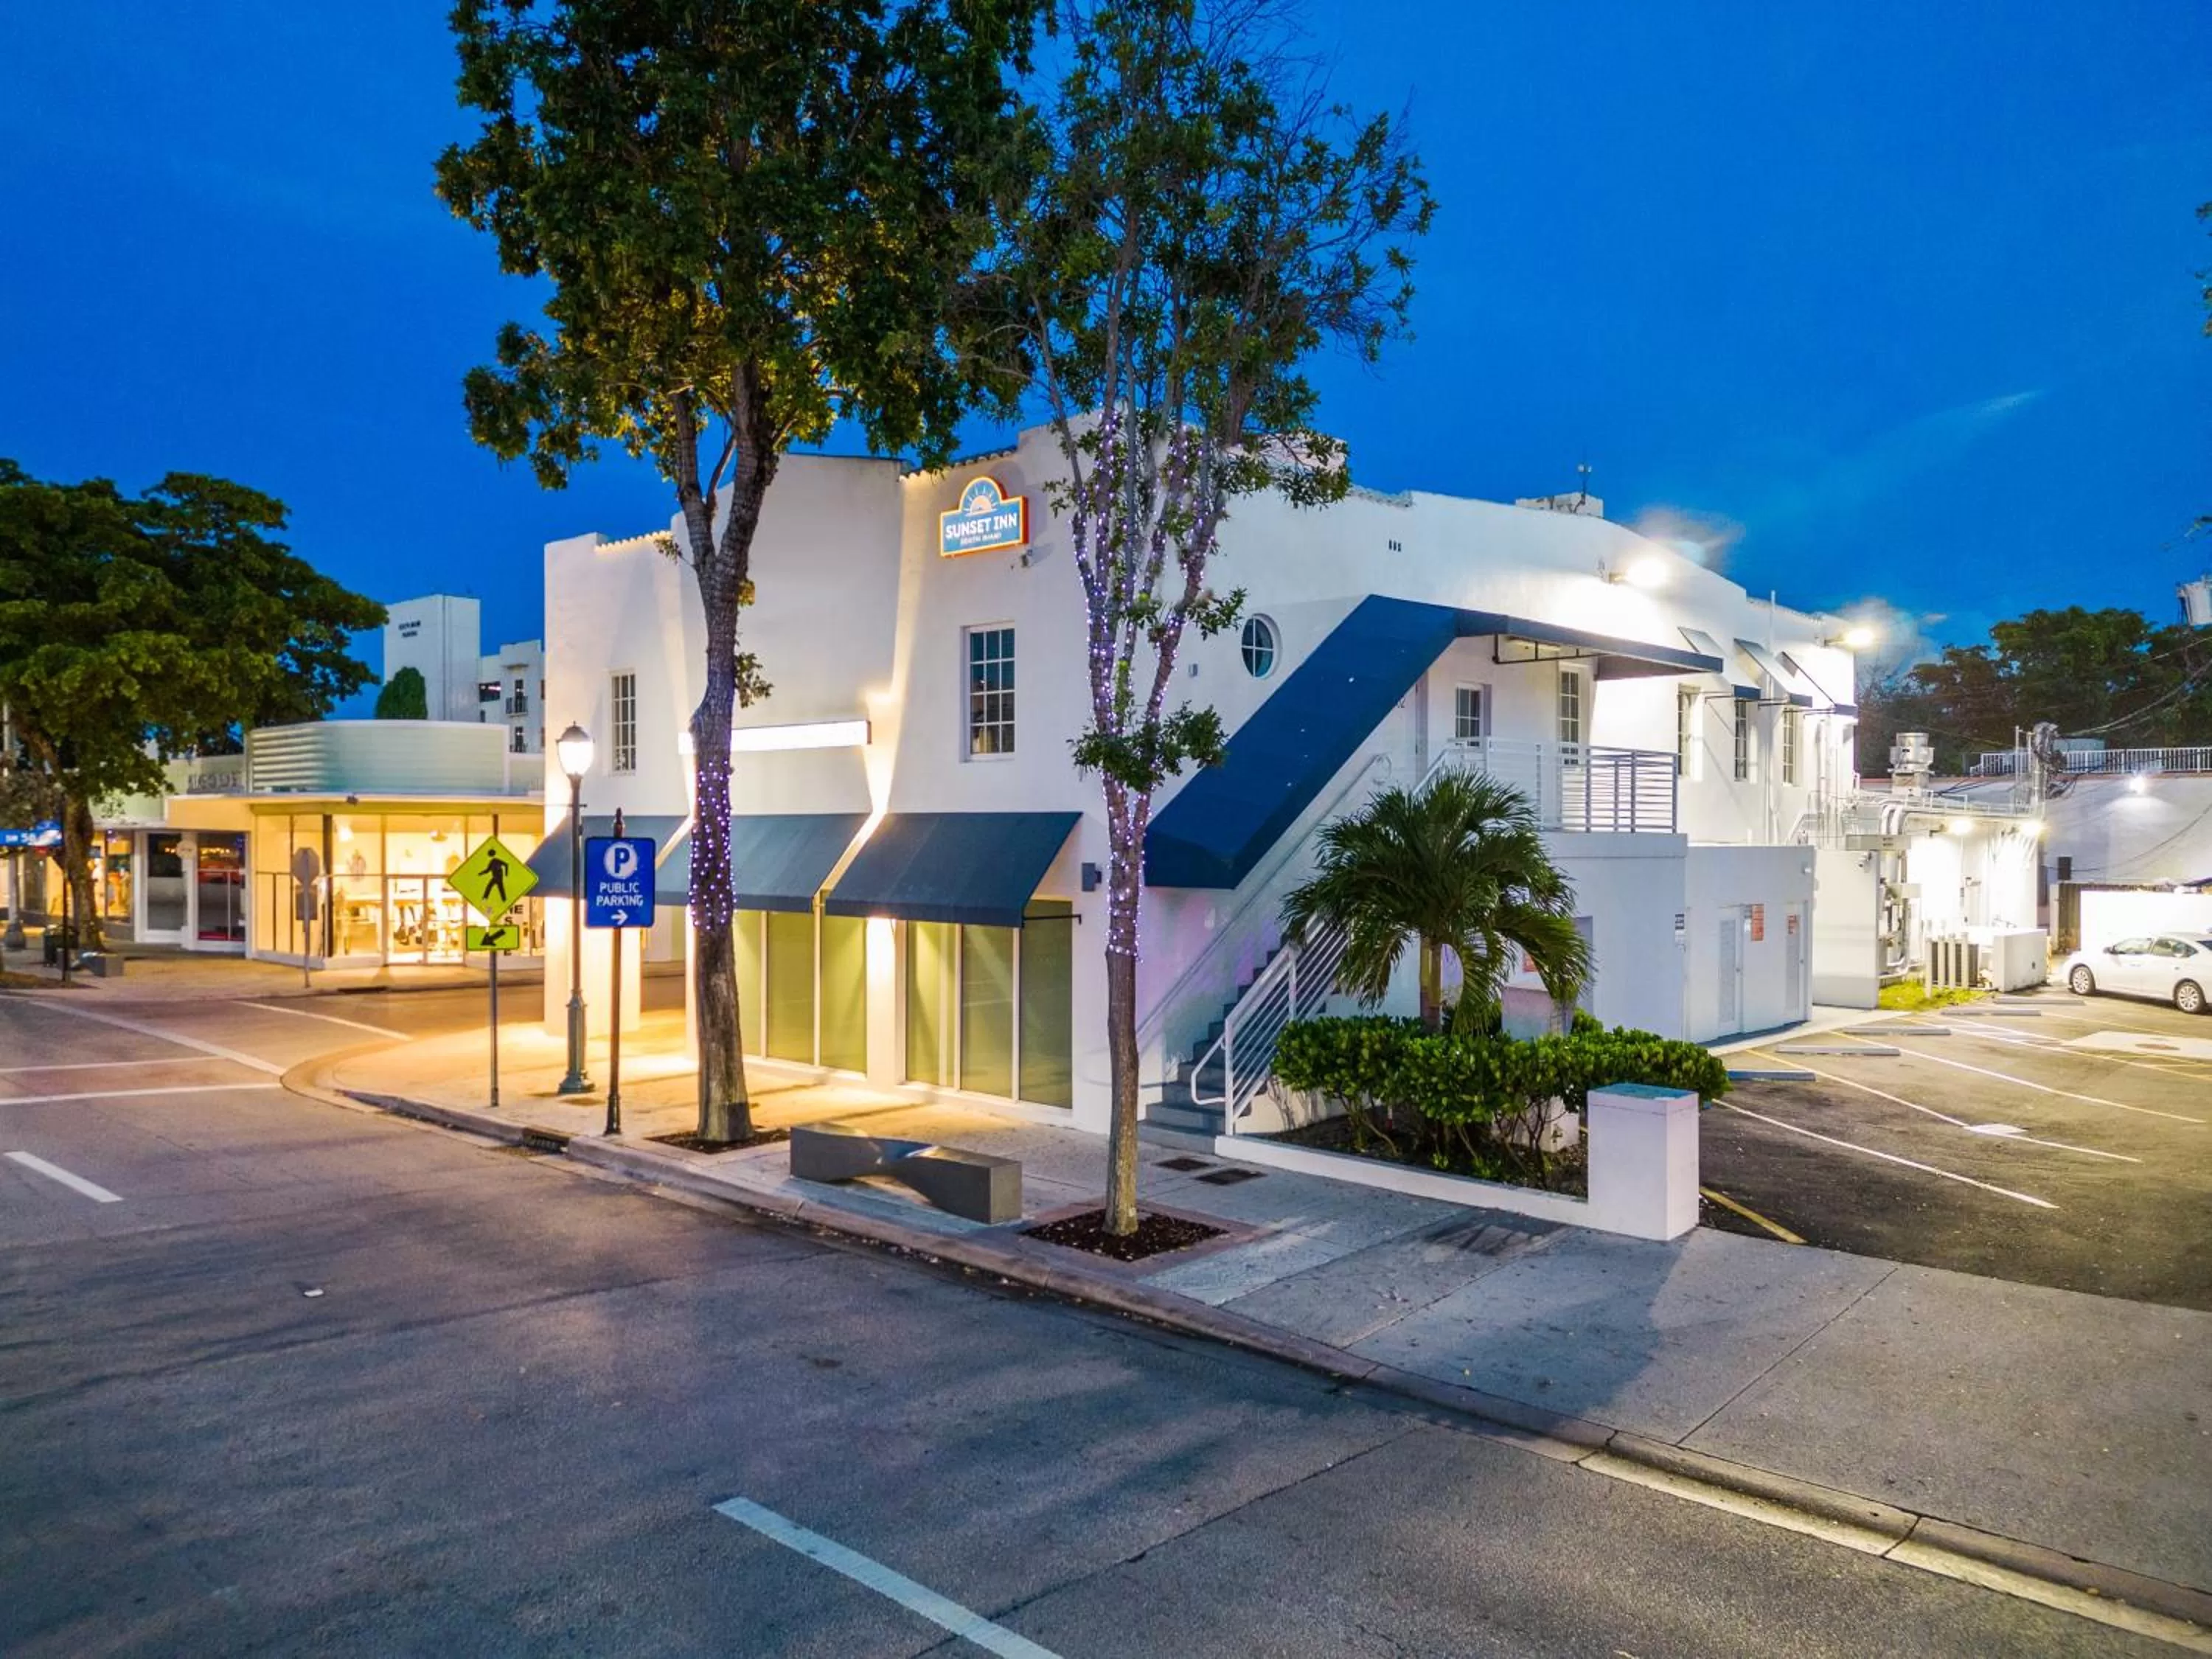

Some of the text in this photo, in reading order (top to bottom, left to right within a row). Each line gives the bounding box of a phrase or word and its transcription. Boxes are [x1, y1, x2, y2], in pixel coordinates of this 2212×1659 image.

[945, 512, 1018, 538] SUNSET INN
[614, 847, 630, 874] P
[599, 882, 640, 893] PUBLIC
[596, 895, 644, 906] PARKING
